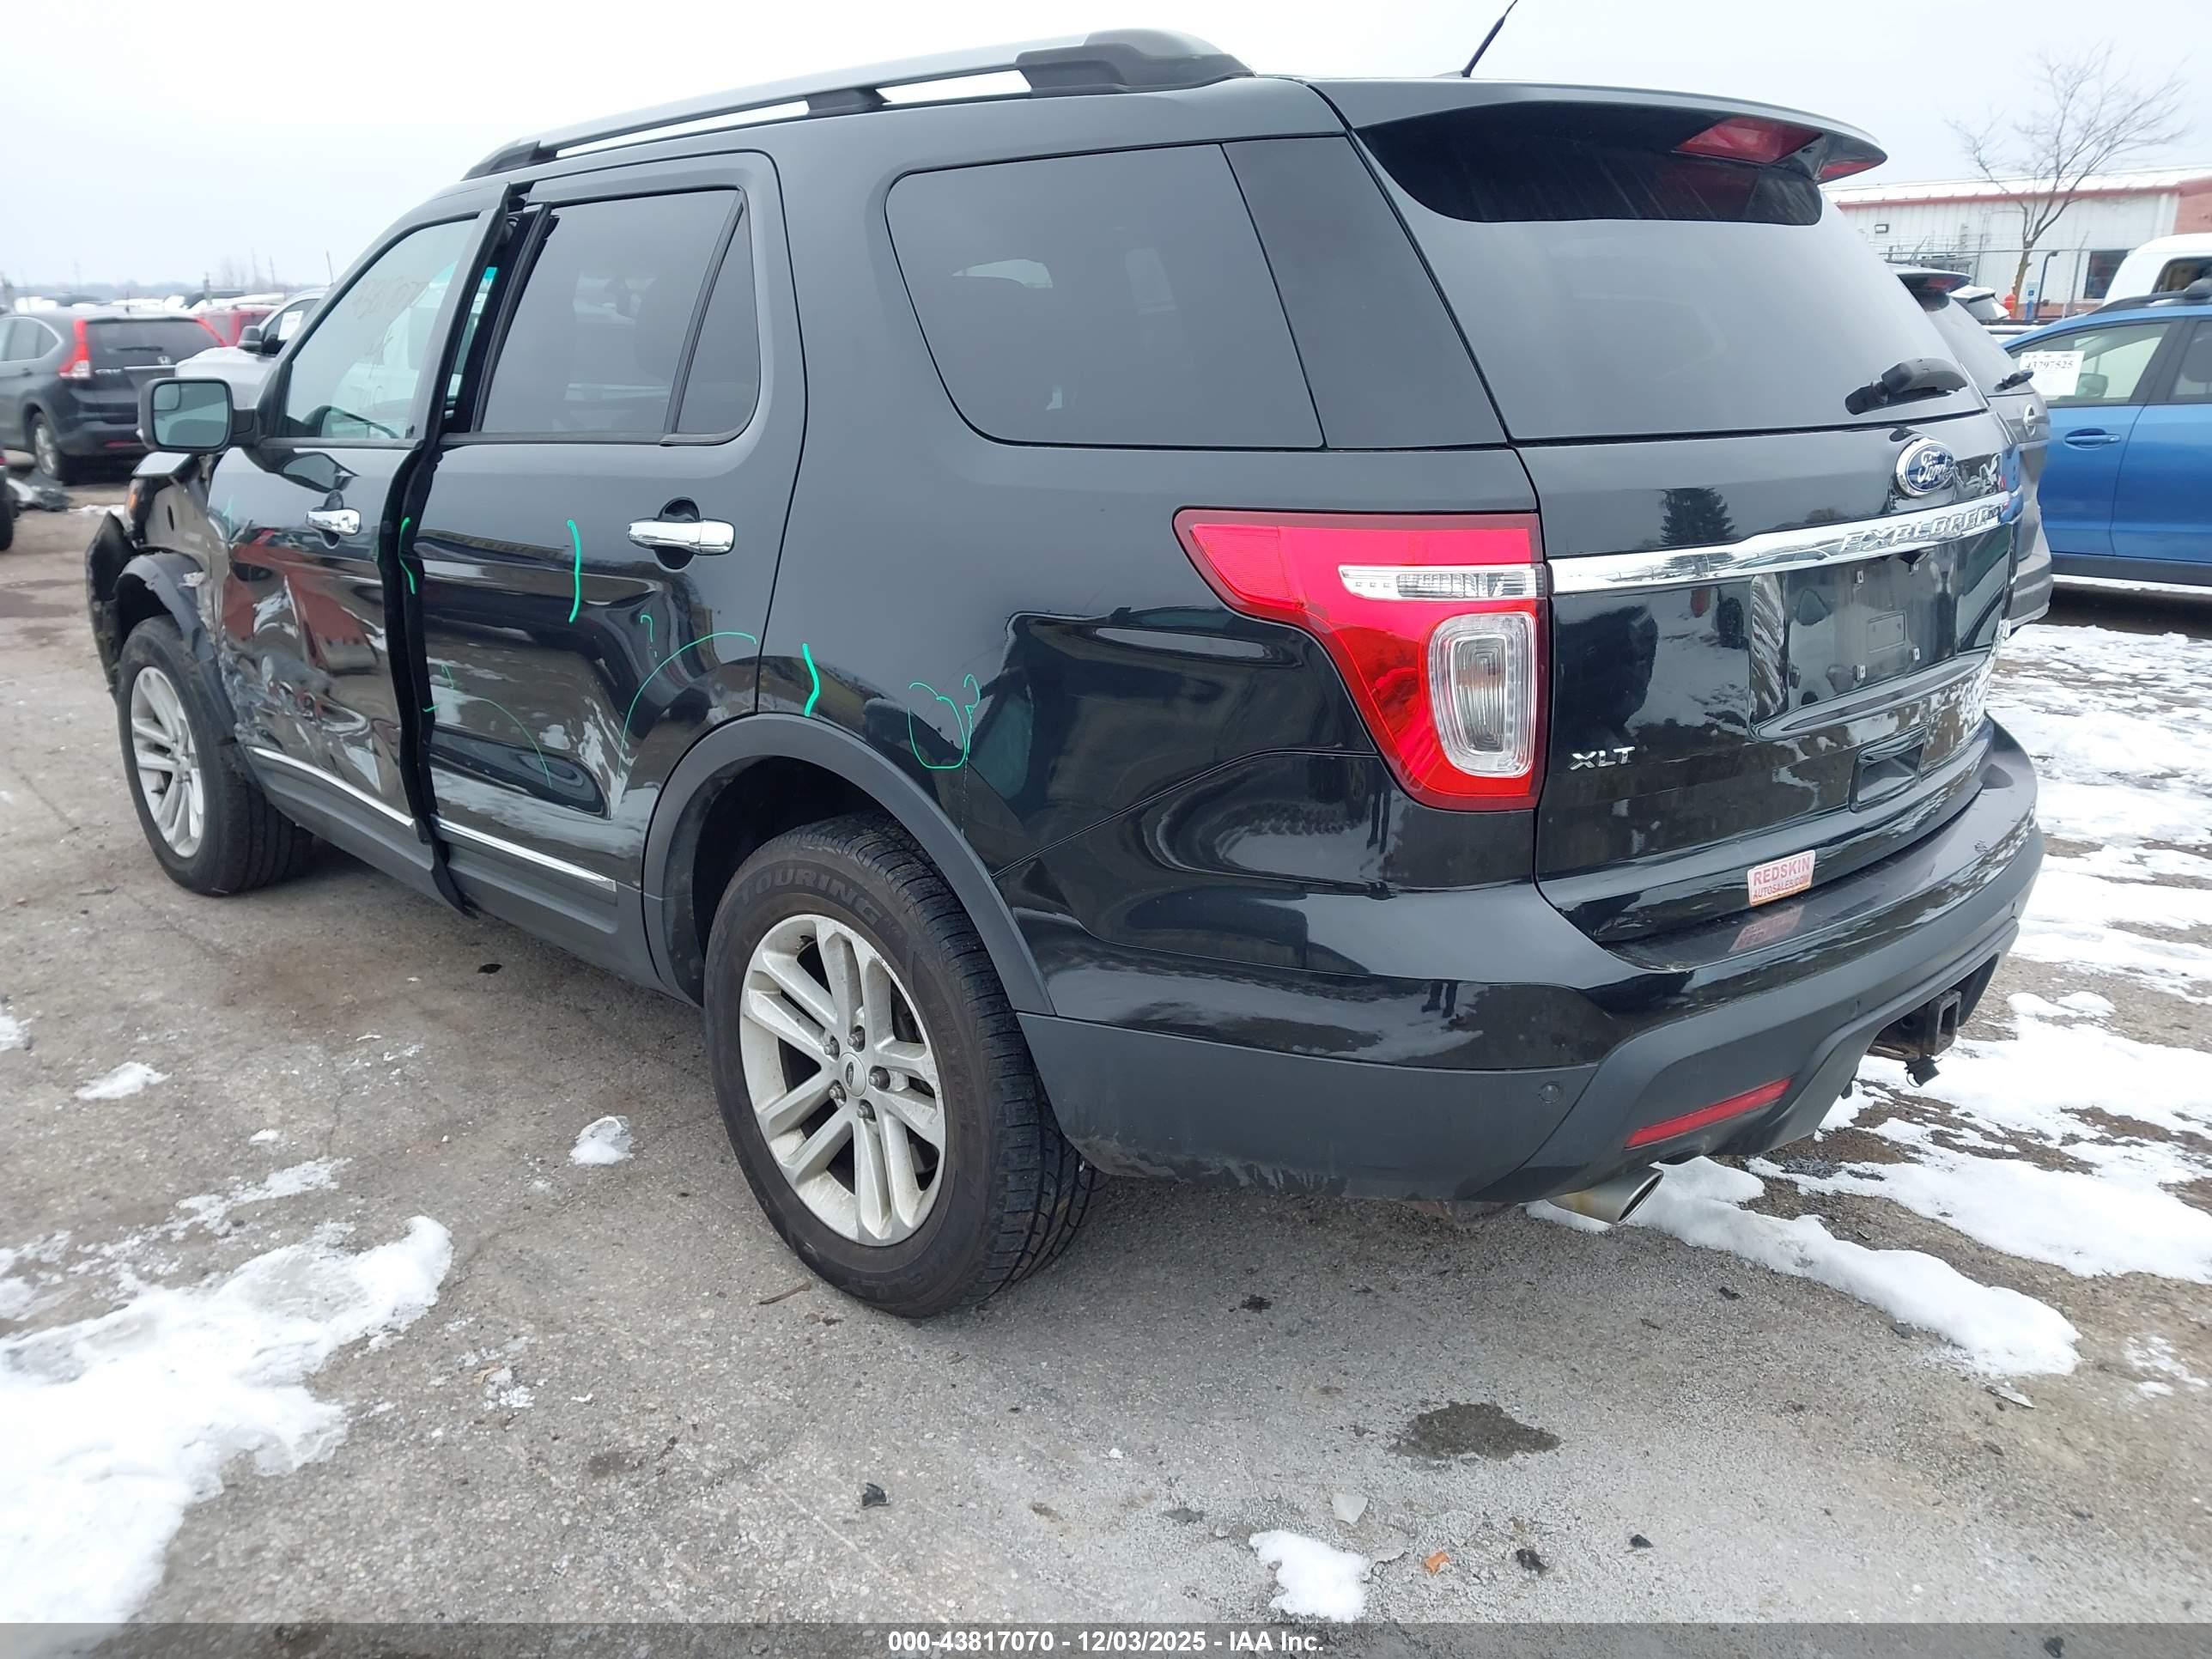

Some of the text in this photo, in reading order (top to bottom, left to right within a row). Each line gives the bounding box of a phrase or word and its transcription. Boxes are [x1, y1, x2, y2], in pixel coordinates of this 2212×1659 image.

[1917, 450, 1955, 483] Ford
[1840, 503, 1994, 552] EXPLORER
[1569, 745, 1636, 770] XLT
[1753, 857, 1811, 886] REDSKIN
[1753, 873, 1810, 901] AUTOSALES.COM
[738, 867, 884, 925] TOURING
